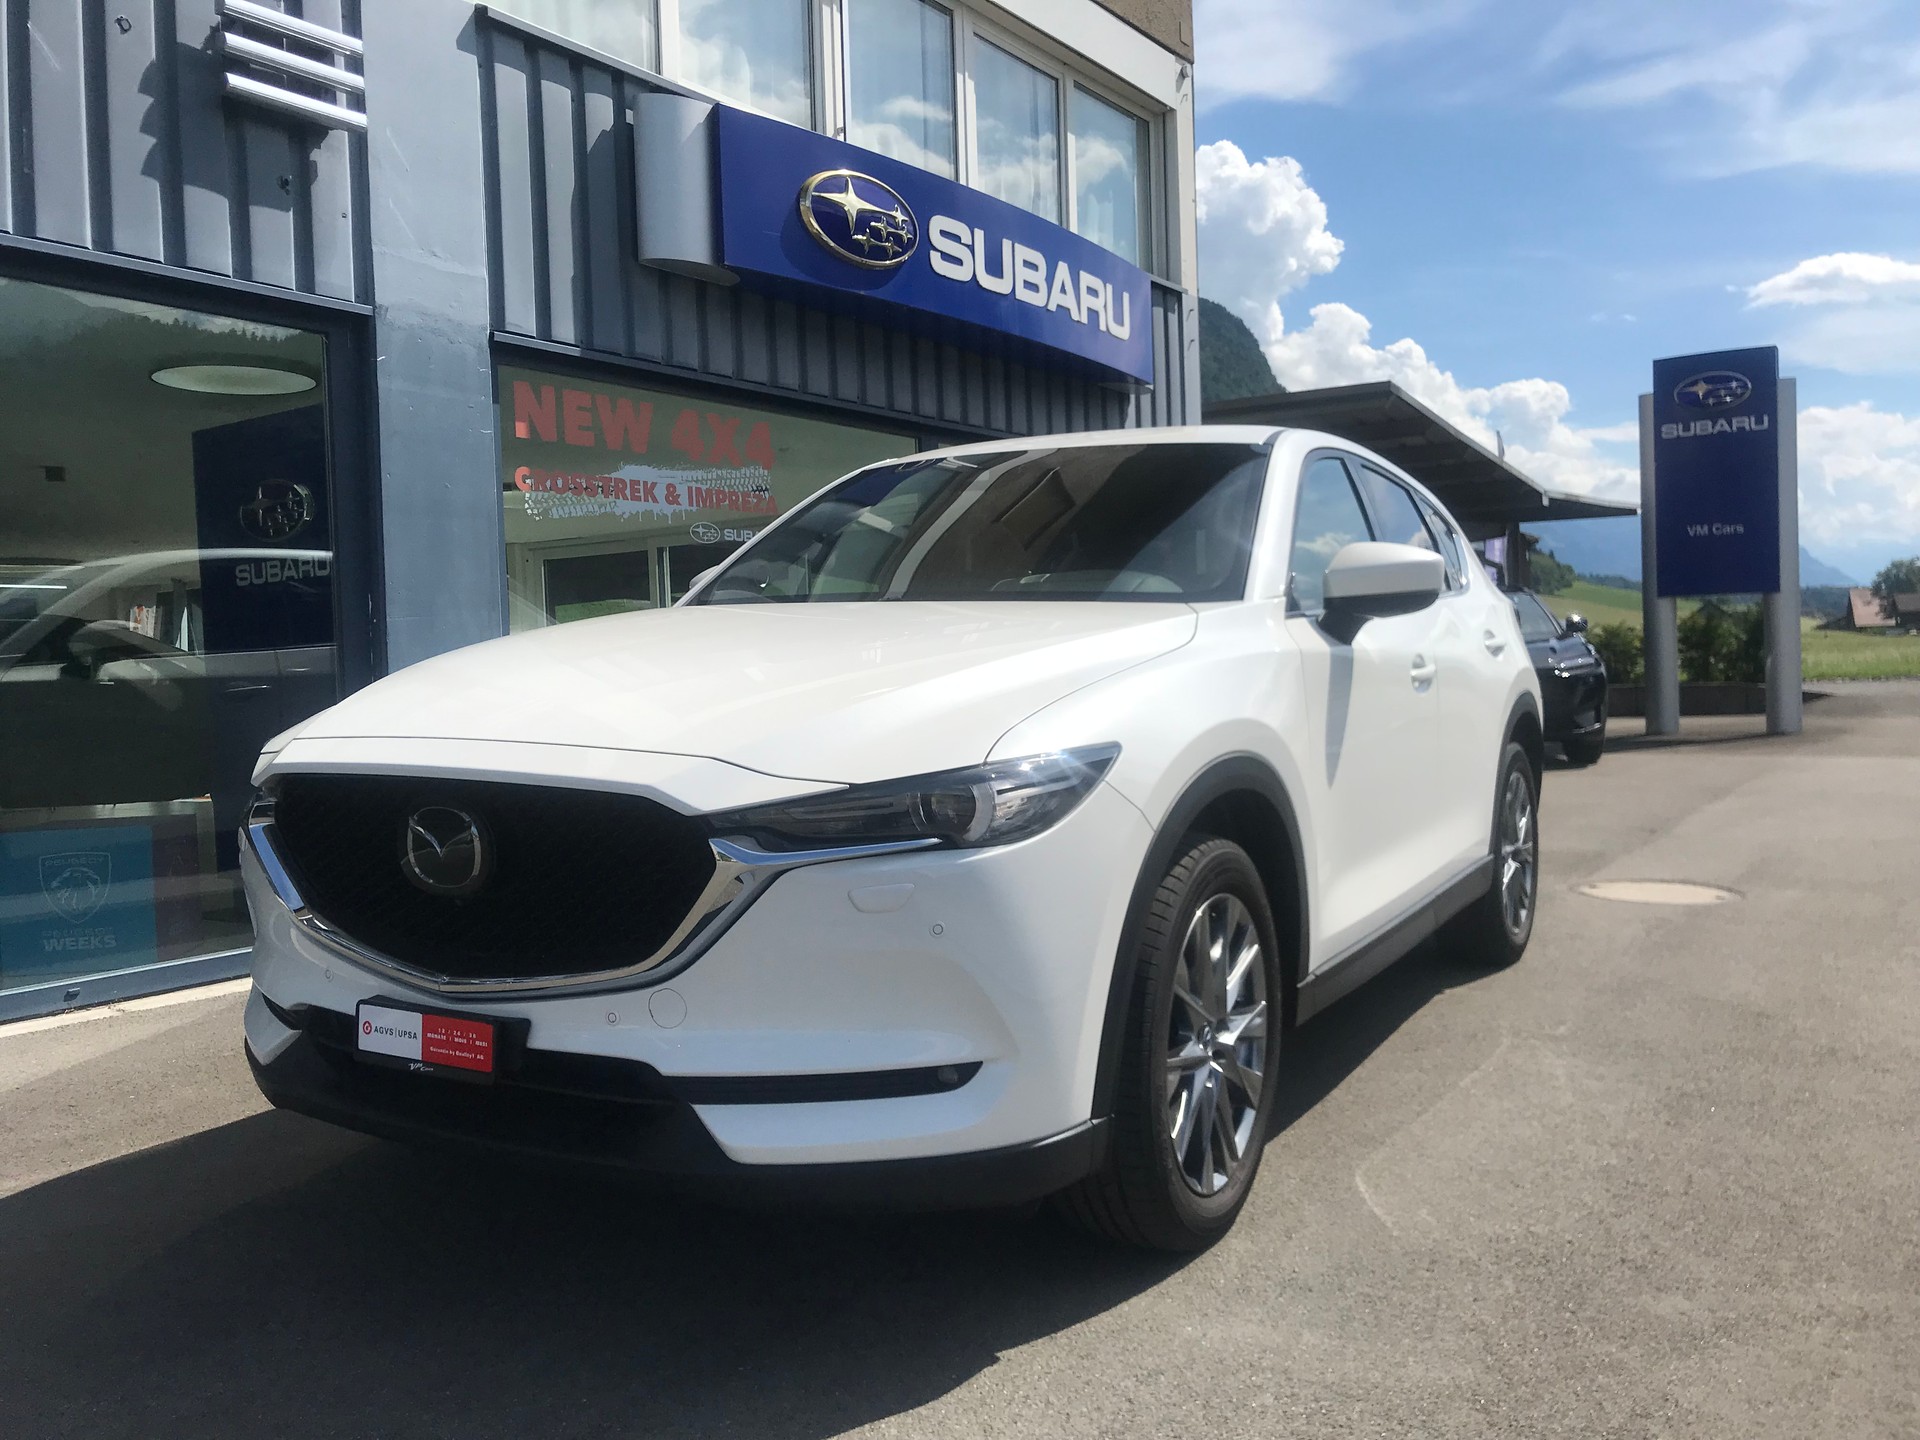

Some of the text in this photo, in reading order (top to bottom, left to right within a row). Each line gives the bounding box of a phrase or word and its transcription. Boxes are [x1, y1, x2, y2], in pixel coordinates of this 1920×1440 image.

[928, 214, 1131, 341] SUBARU
[513, 381, 776, 470] NEW 4X4
[1661, 414, 1769, 440] SUBARU
[514, 466, 778, 515] CROSSTREK & IMPREZA
[724, 528, 759, 542] SUB
[1687, 522, 1744, 537] VM Cars
[236, 558, 331, 586] SUBARU
[42, 935, 117, 952] WEEKS
